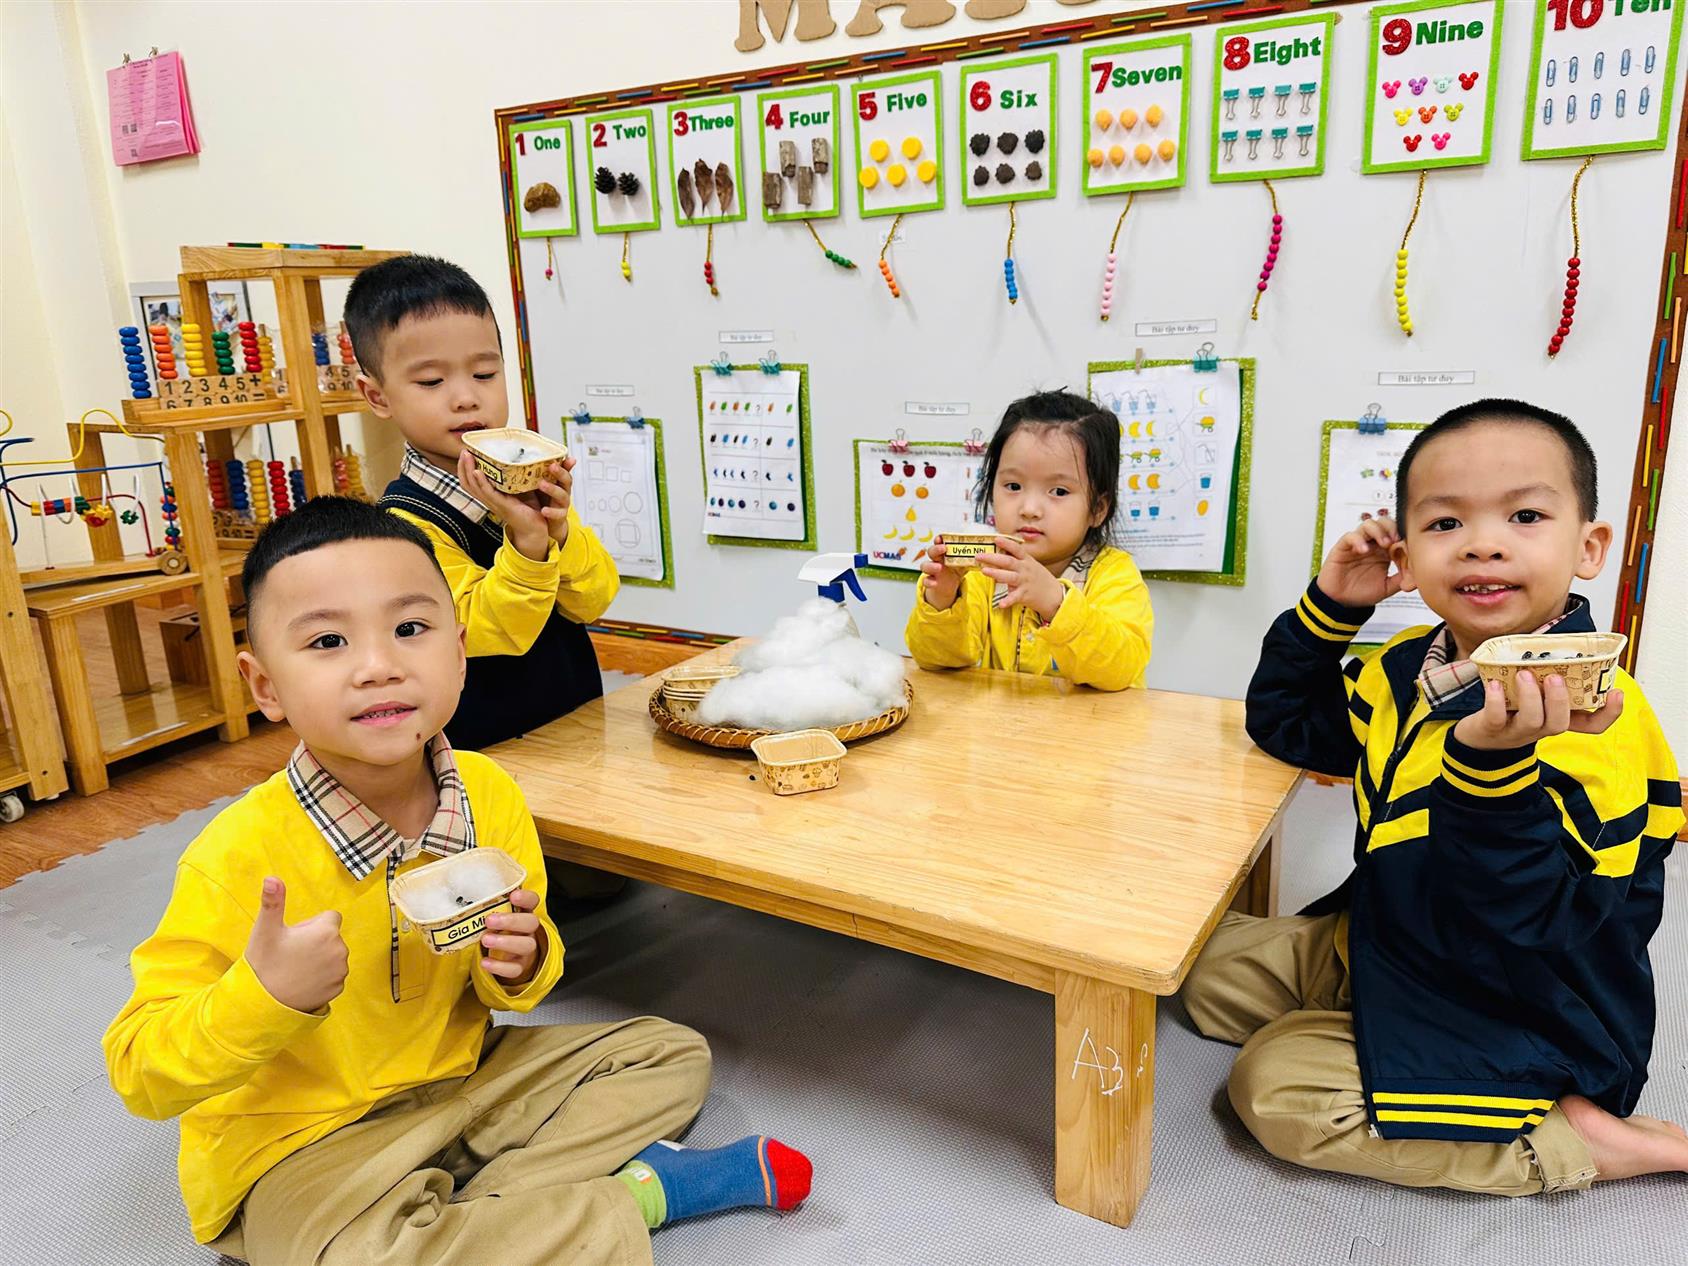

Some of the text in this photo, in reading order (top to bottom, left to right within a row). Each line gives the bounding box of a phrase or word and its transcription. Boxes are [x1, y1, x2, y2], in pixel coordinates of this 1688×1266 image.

[1547, 0, 1671, 31] 10 Ten
[1382, 18, 1484, 56] 9 Nine
[1223, 36, 1321, 71] 8 Eight
[1091, 61, 1182, 94] 7 Seven
[858, 92, 927, 121] 5 Five
[969, 81, 1038, 112] 6 Six
[673, 111, 734, 136] 3 Three
[765, 104, 830, 129] 4 Four
[514, 133, 561, 156] 1 One
[592, 123, 647, 147] 2 Two
[164, 381, 173, 395] 1
[182, 380, 193, 394] 2
[199, 378, 210, 392] 3
[219, 377, 228, 390] 4
[236, 377, 246, 390] 5
[235, 394, 248, 403] 10
[448, 926, 470, 939] Gia
